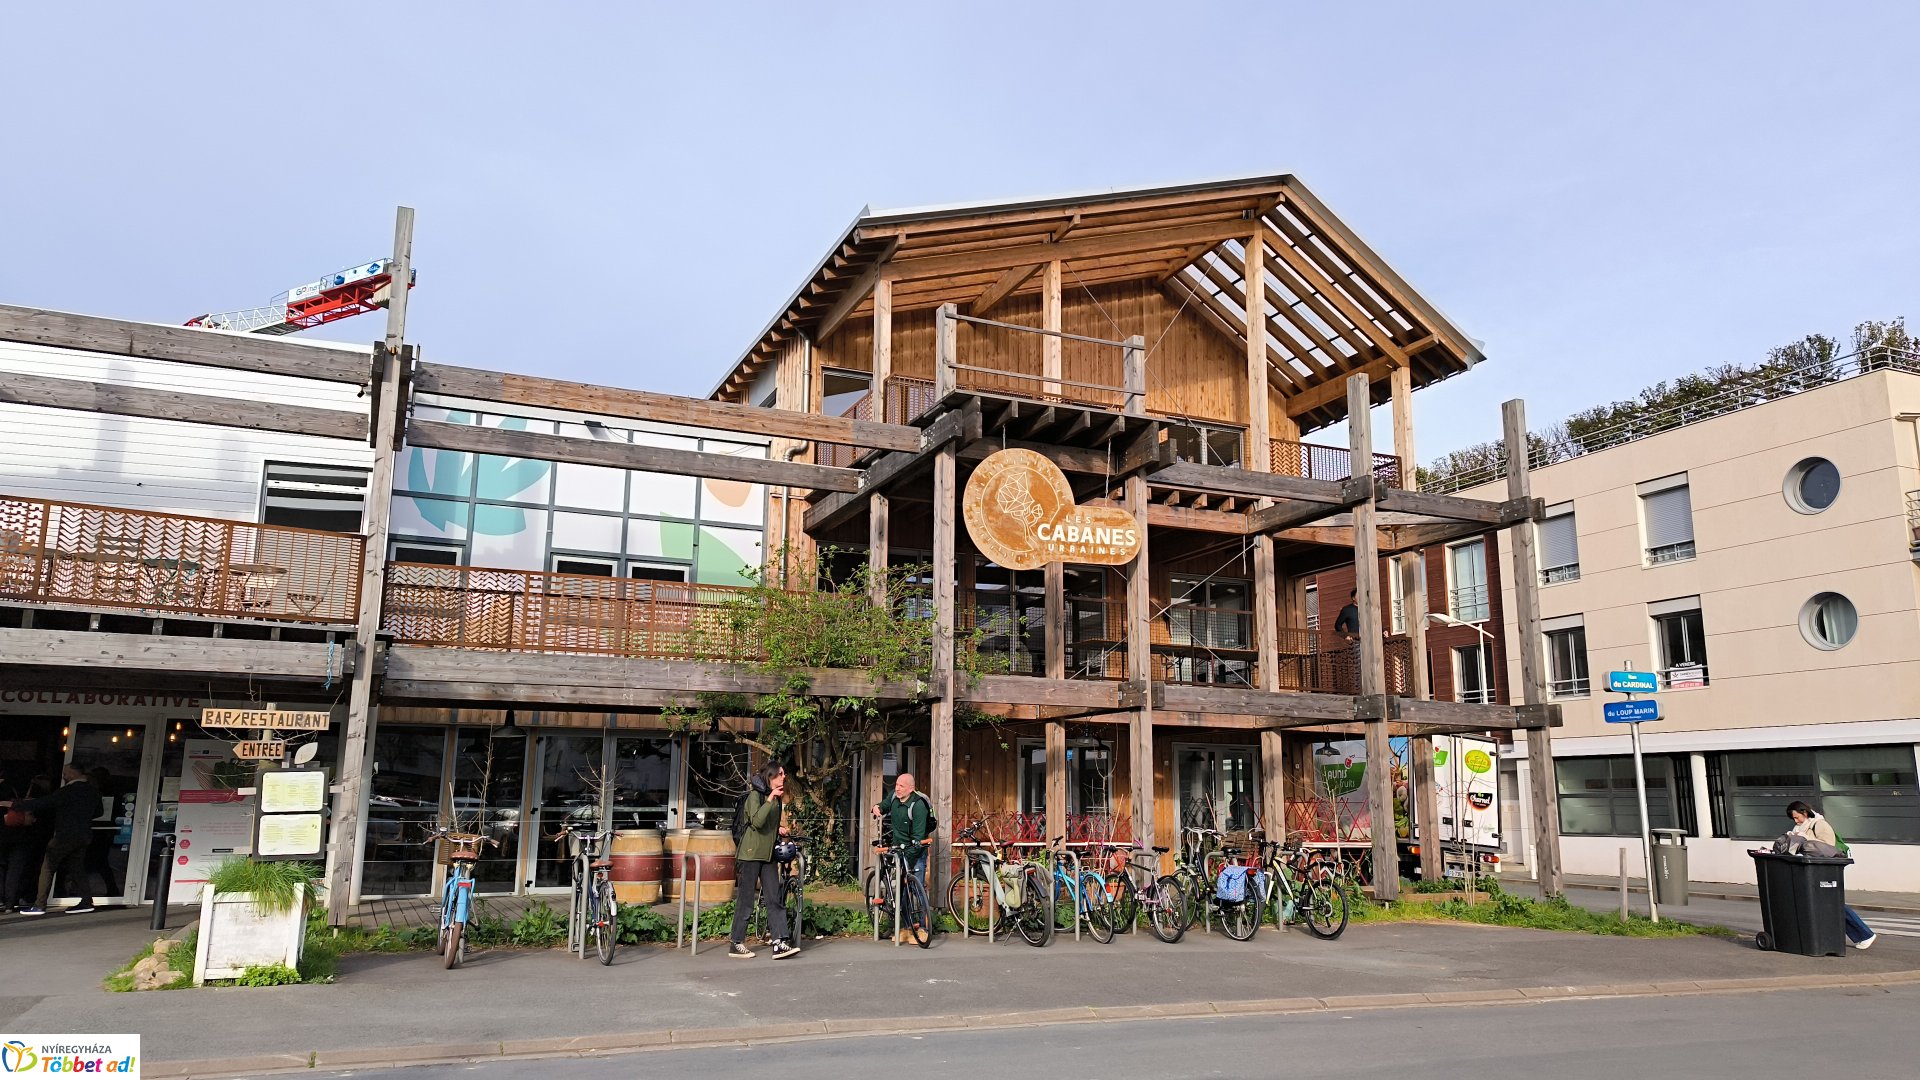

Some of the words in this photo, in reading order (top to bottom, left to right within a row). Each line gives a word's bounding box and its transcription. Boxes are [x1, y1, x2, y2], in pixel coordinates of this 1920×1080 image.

[1066, 516, 1092, 524] LES
[1037, 523, 1136, 546] CABANES
[1048, 544, 1126, 556] URBAINES
[1622, 681, 1654, 689] CARDINAL
[1, 690, 200, 708] COLLABORATIVE
[1634, 707, 1654, 715] MARIN
[205, 710, 329, 728] BAR/RESTAURANT
